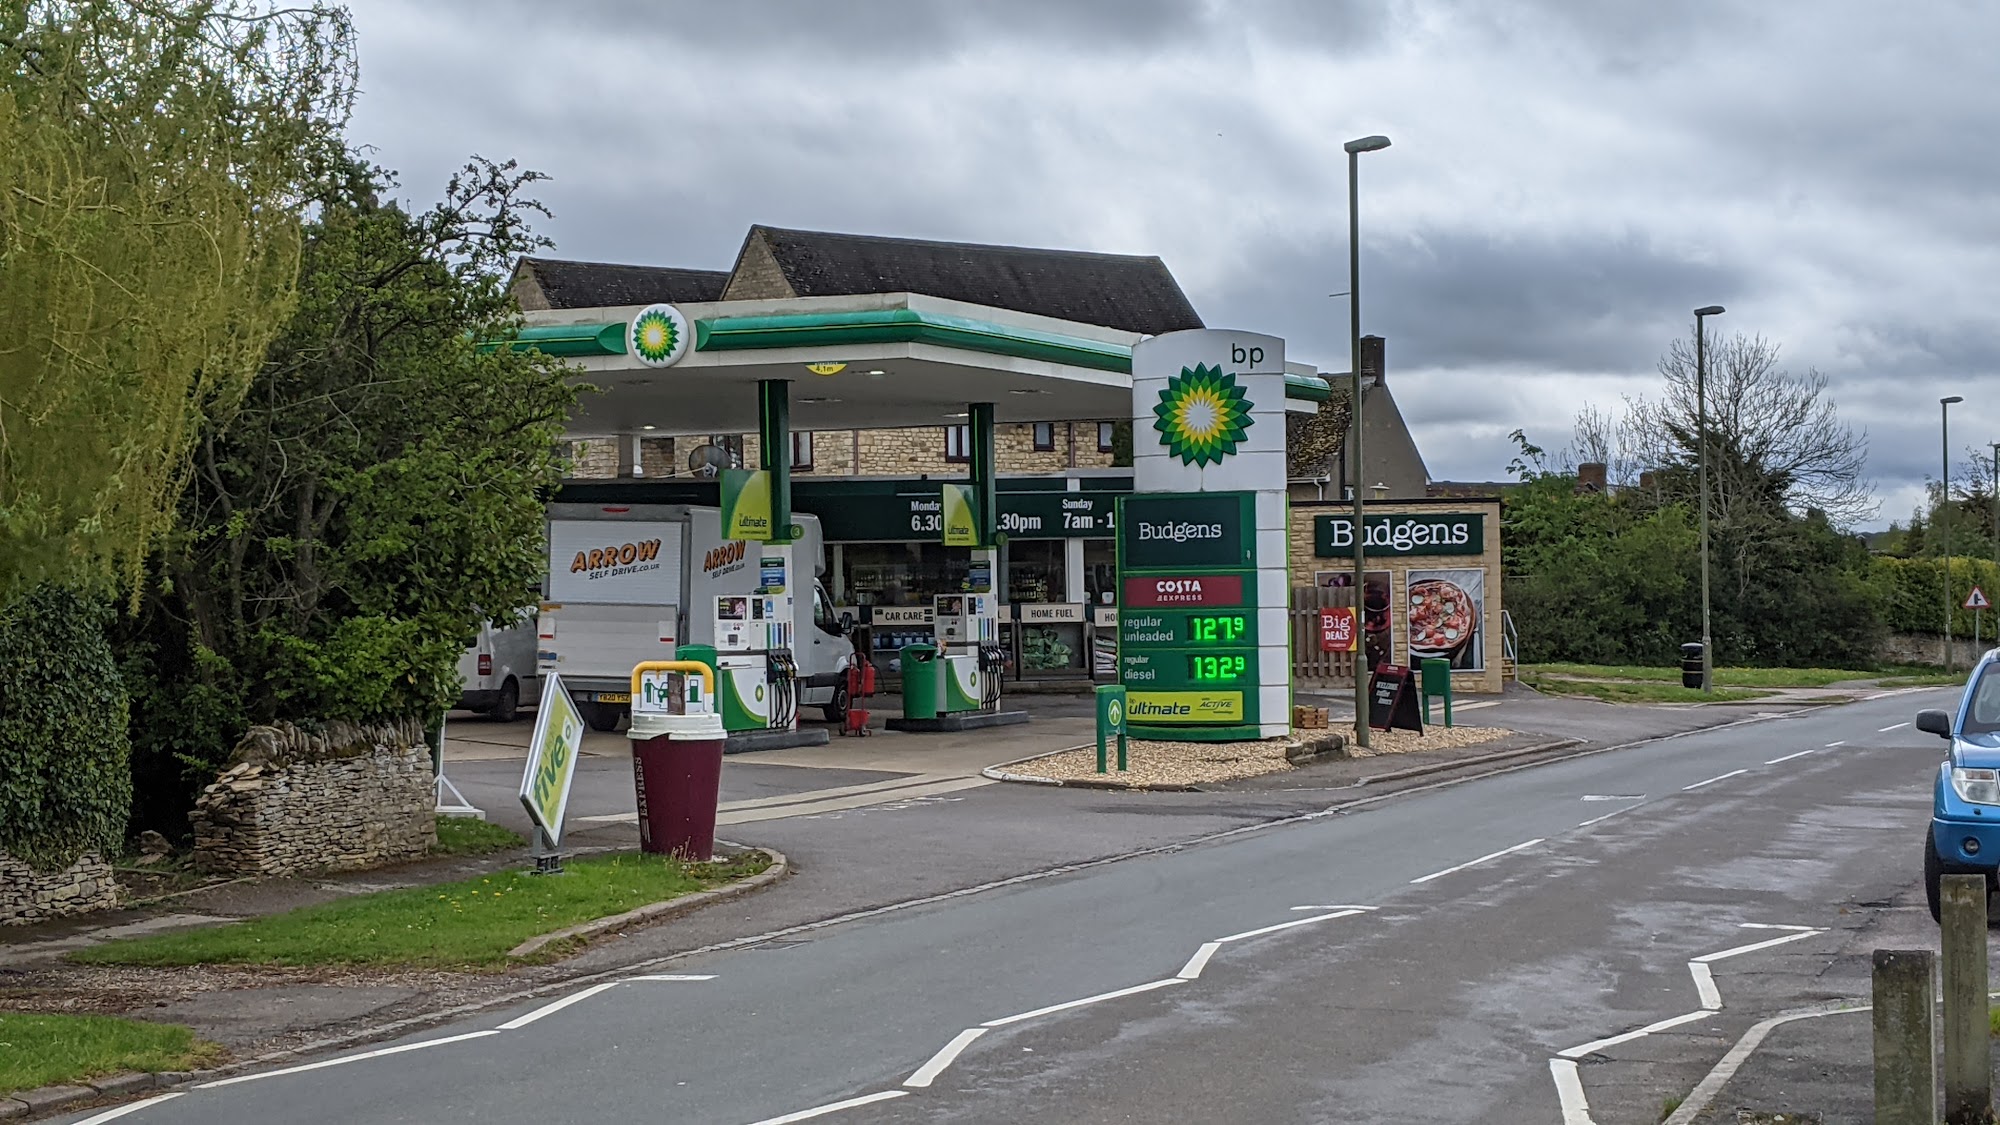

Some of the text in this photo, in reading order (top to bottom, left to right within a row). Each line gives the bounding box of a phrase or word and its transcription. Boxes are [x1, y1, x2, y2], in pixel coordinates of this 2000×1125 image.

[1232, 343, 1264, 369] bp
[1062, 499, 1093, 511] Sunday
[1063, 512, 1094, 529] 7am
[1139, 521, 1222, 542] Budgens
[570, 538, 662, 574] ARROW
[703, 539, 746, 573] ARROW
[589, 570, 609, 580] SELF
[1156, 580, 1202, 594] COSTA
[1163, 594, 1203, 602] EXPRESS
[885, 611, 901, 621] CAR
[903, 611, 923, 620] CARE
[1031, 609, 1074, 619] HOME FUEL
[1104, 614, 1118, 622] HO
[1124, 616, 1162, 629] regular
[1321, 615, 1352, 631] Big
[1124, 630, 1174, 641] unleaded
[1325, 631, 1350, 640] DEALS
[1124, 655, 1149, 665] regular
[1124, 669, 1155, 680] diesel
[1129, 702, 1190, 715] ultimate
